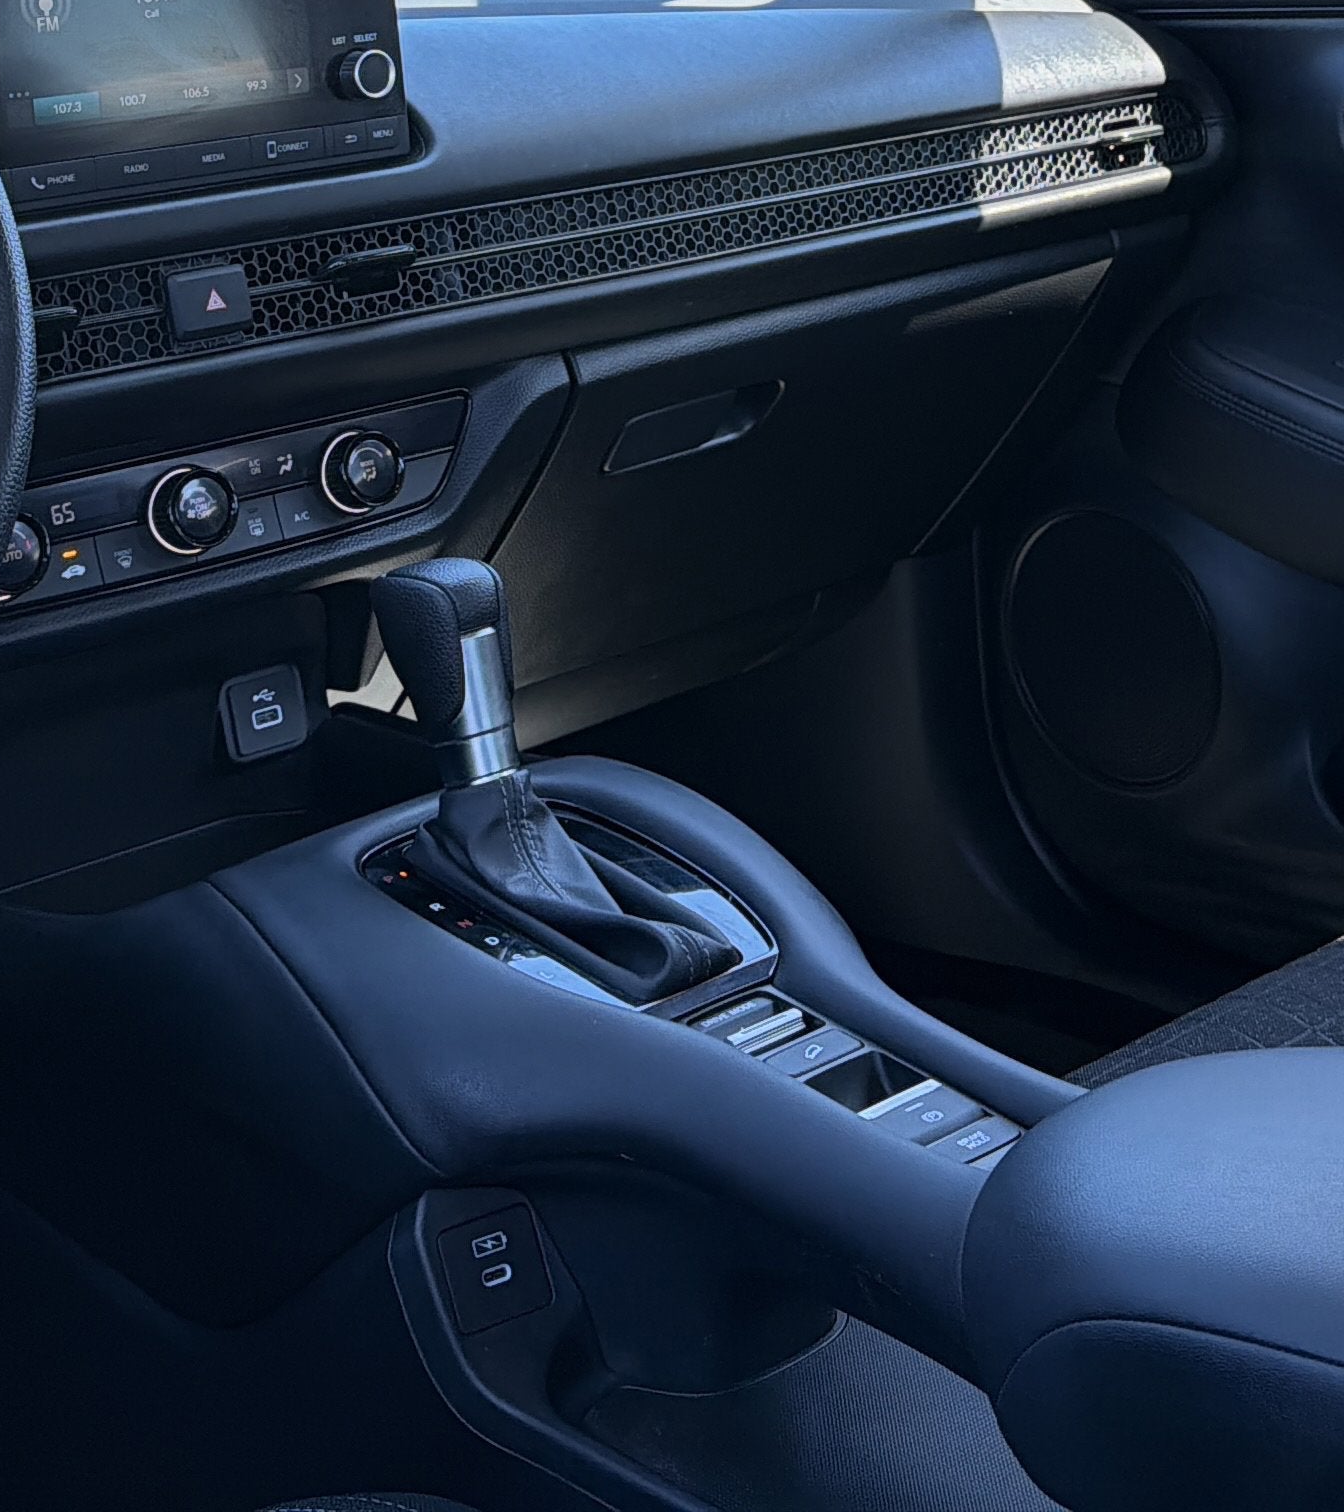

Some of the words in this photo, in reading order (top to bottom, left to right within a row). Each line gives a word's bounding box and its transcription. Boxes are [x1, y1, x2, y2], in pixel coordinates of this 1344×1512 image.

[36, 16, 60, 33] FM
[353, 33, 378, 43] SELECT
[182, 87, 210, 99] 106.5
[119, 94, 147, 107] 100.7
[53, 104, 82, 116] 107.3
[277, 141, 309, 154] CONNECT
[202, 153, 226, 164] MEDIA
[123, 163, 150, 175] RADIO
[47, 173, 77, 186] PHONE
[50, 501, 76, 526] 65
[294, 511, 310, 523] A/C
